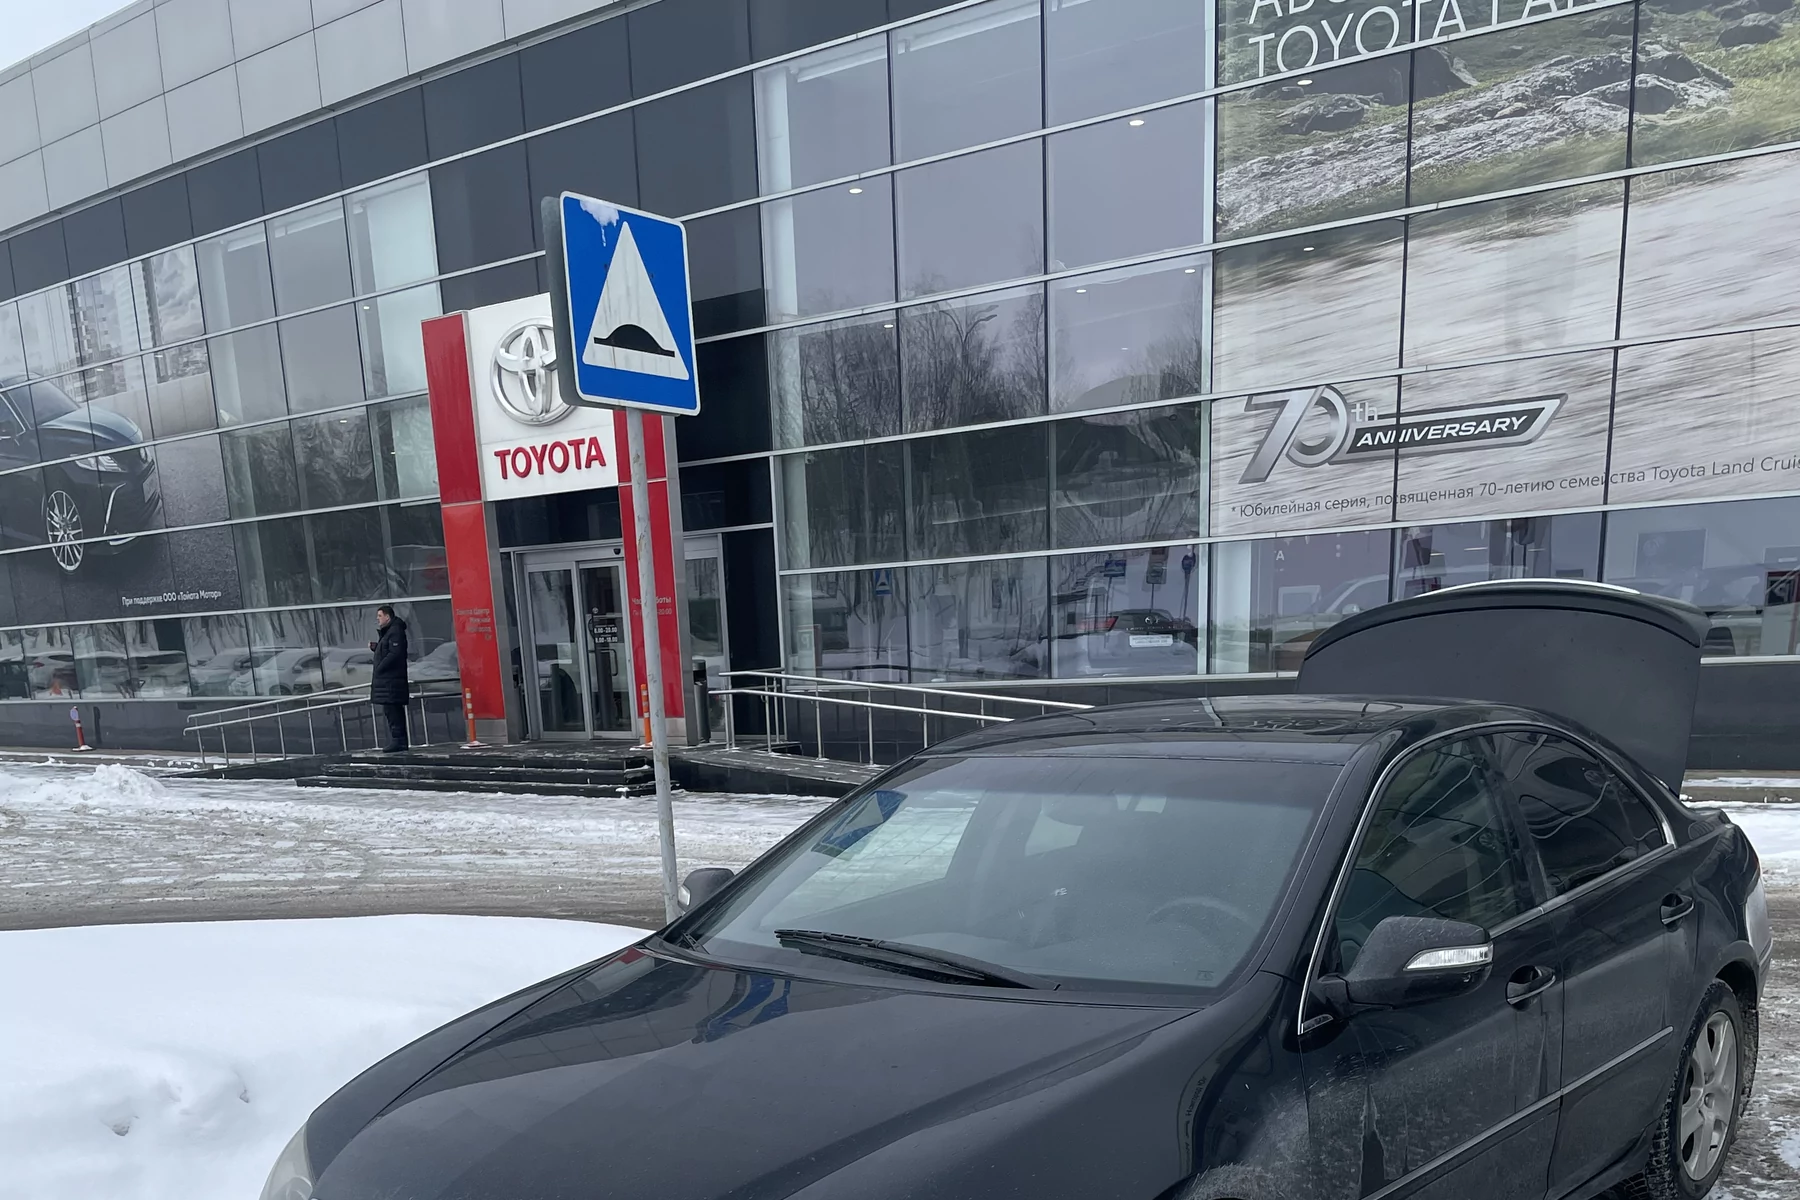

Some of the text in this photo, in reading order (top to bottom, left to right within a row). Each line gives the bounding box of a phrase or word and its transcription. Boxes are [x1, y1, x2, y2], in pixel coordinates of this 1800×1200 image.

[1249, 0, 1467, 77] TOYOTA
[1356, 415, 1528, 447] ANNIVERSARY
[494, 436, 607, 480] TOYOTA
[1240, 501, 1321, 518] Юбилейная
[1324, 497, 1370, 513] серия,
[1375, 486, 1474, 506] повященная
[1479, 482, 1555, 497] 70-летию
[1652, 462, 1706, 483] Toyota
[1712, 457, 1755, 477] Land
